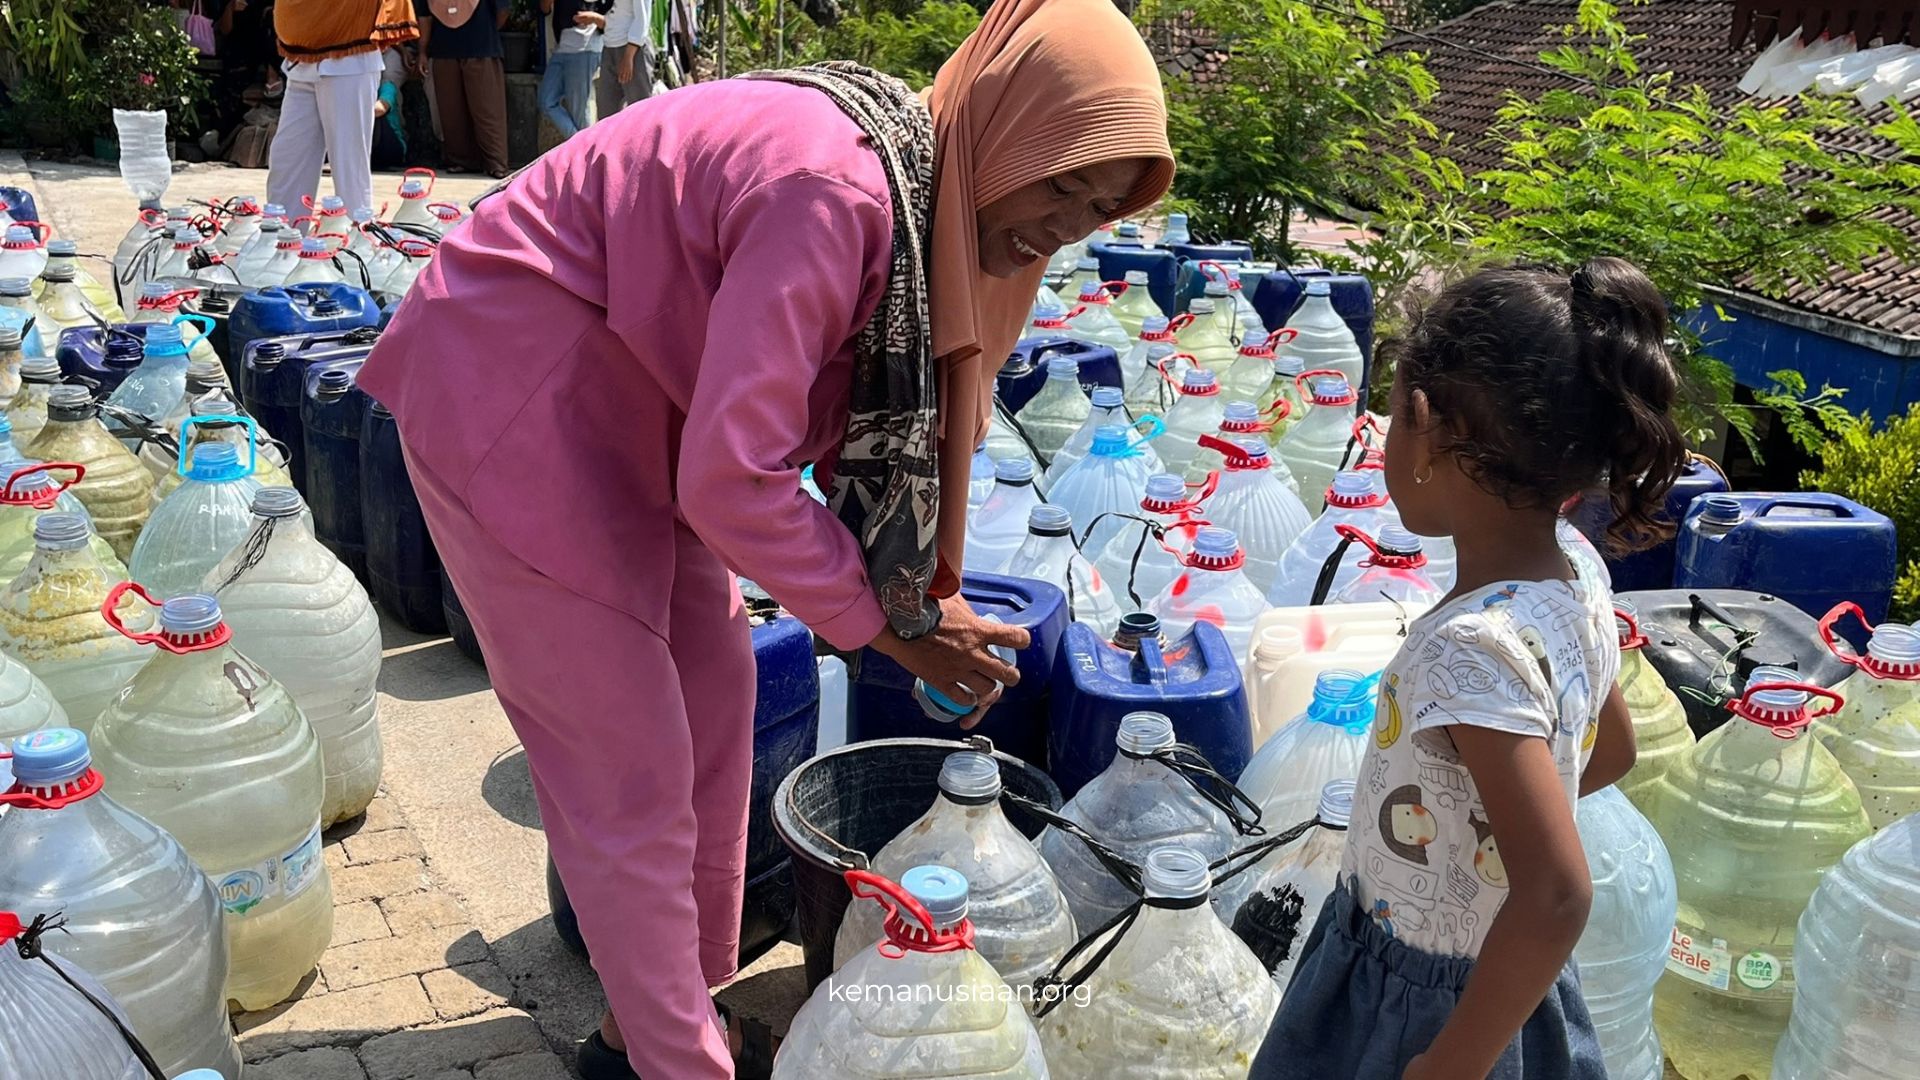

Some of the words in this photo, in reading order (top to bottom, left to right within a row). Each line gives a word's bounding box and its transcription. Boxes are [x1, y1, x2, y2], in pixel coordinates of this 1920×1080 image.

[1672, 928, 1691, 949] Le
[1746, 960, 1772, 970] BPA
[1745, 967, 1772, 977] FREE
